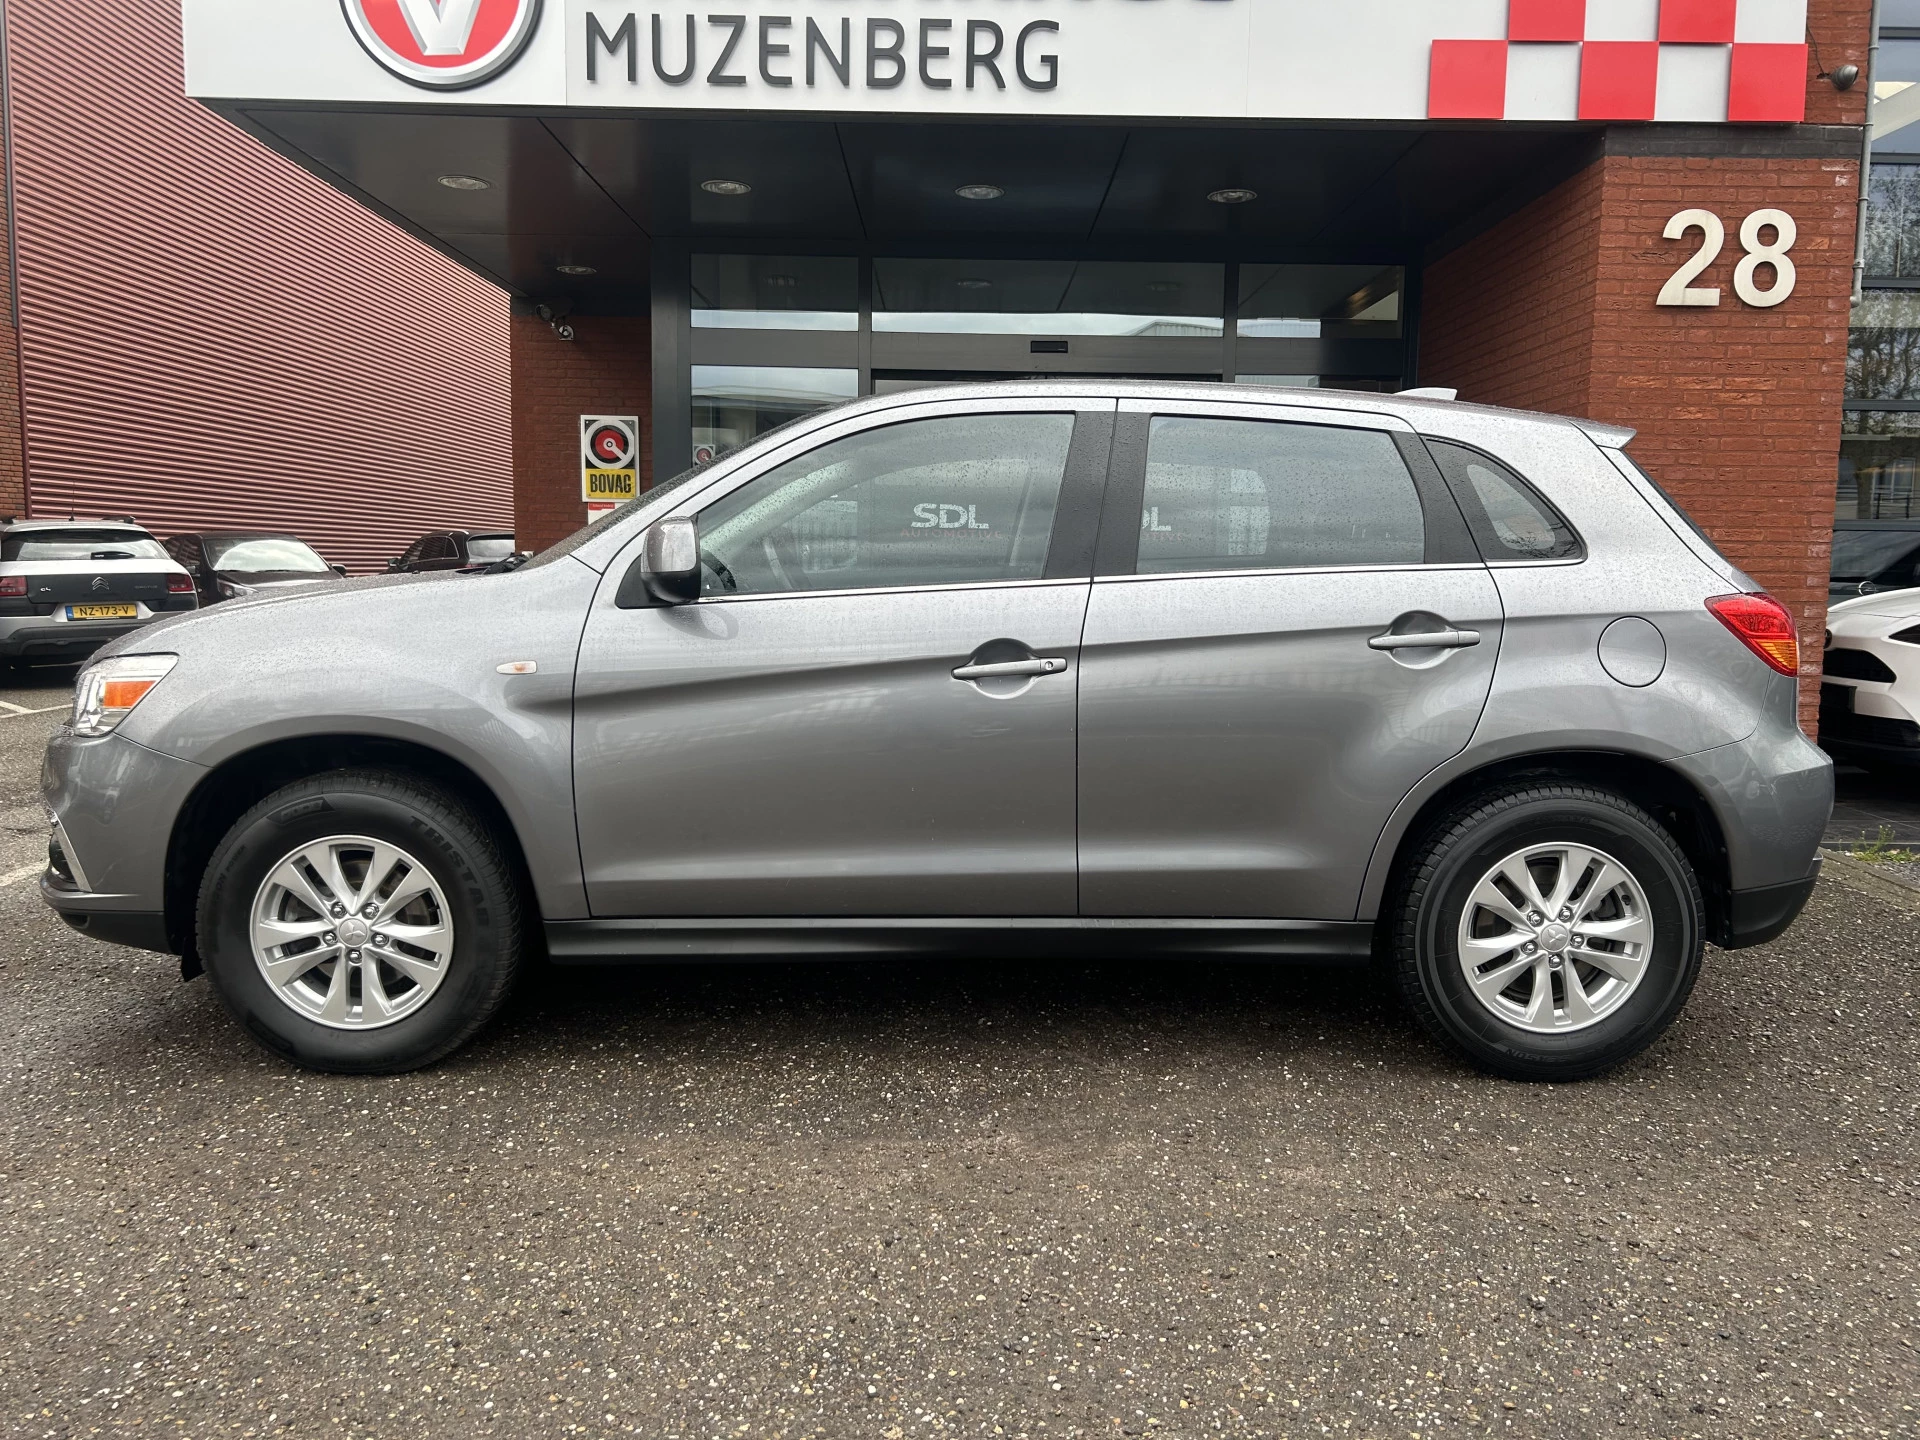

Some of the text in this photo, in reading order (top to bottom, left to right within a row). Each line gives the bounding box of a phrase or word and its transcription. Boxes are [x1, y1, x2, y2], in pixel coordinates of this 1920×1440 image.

[586, 12, 1060, 90] MUZENBERG
[1655, 208, 1797, 307] 28
[590, 474, 631, 493] BOVAG
[911, 503, 990, 529] SDL
[79, 606, 130, 616] NZ-173-V
